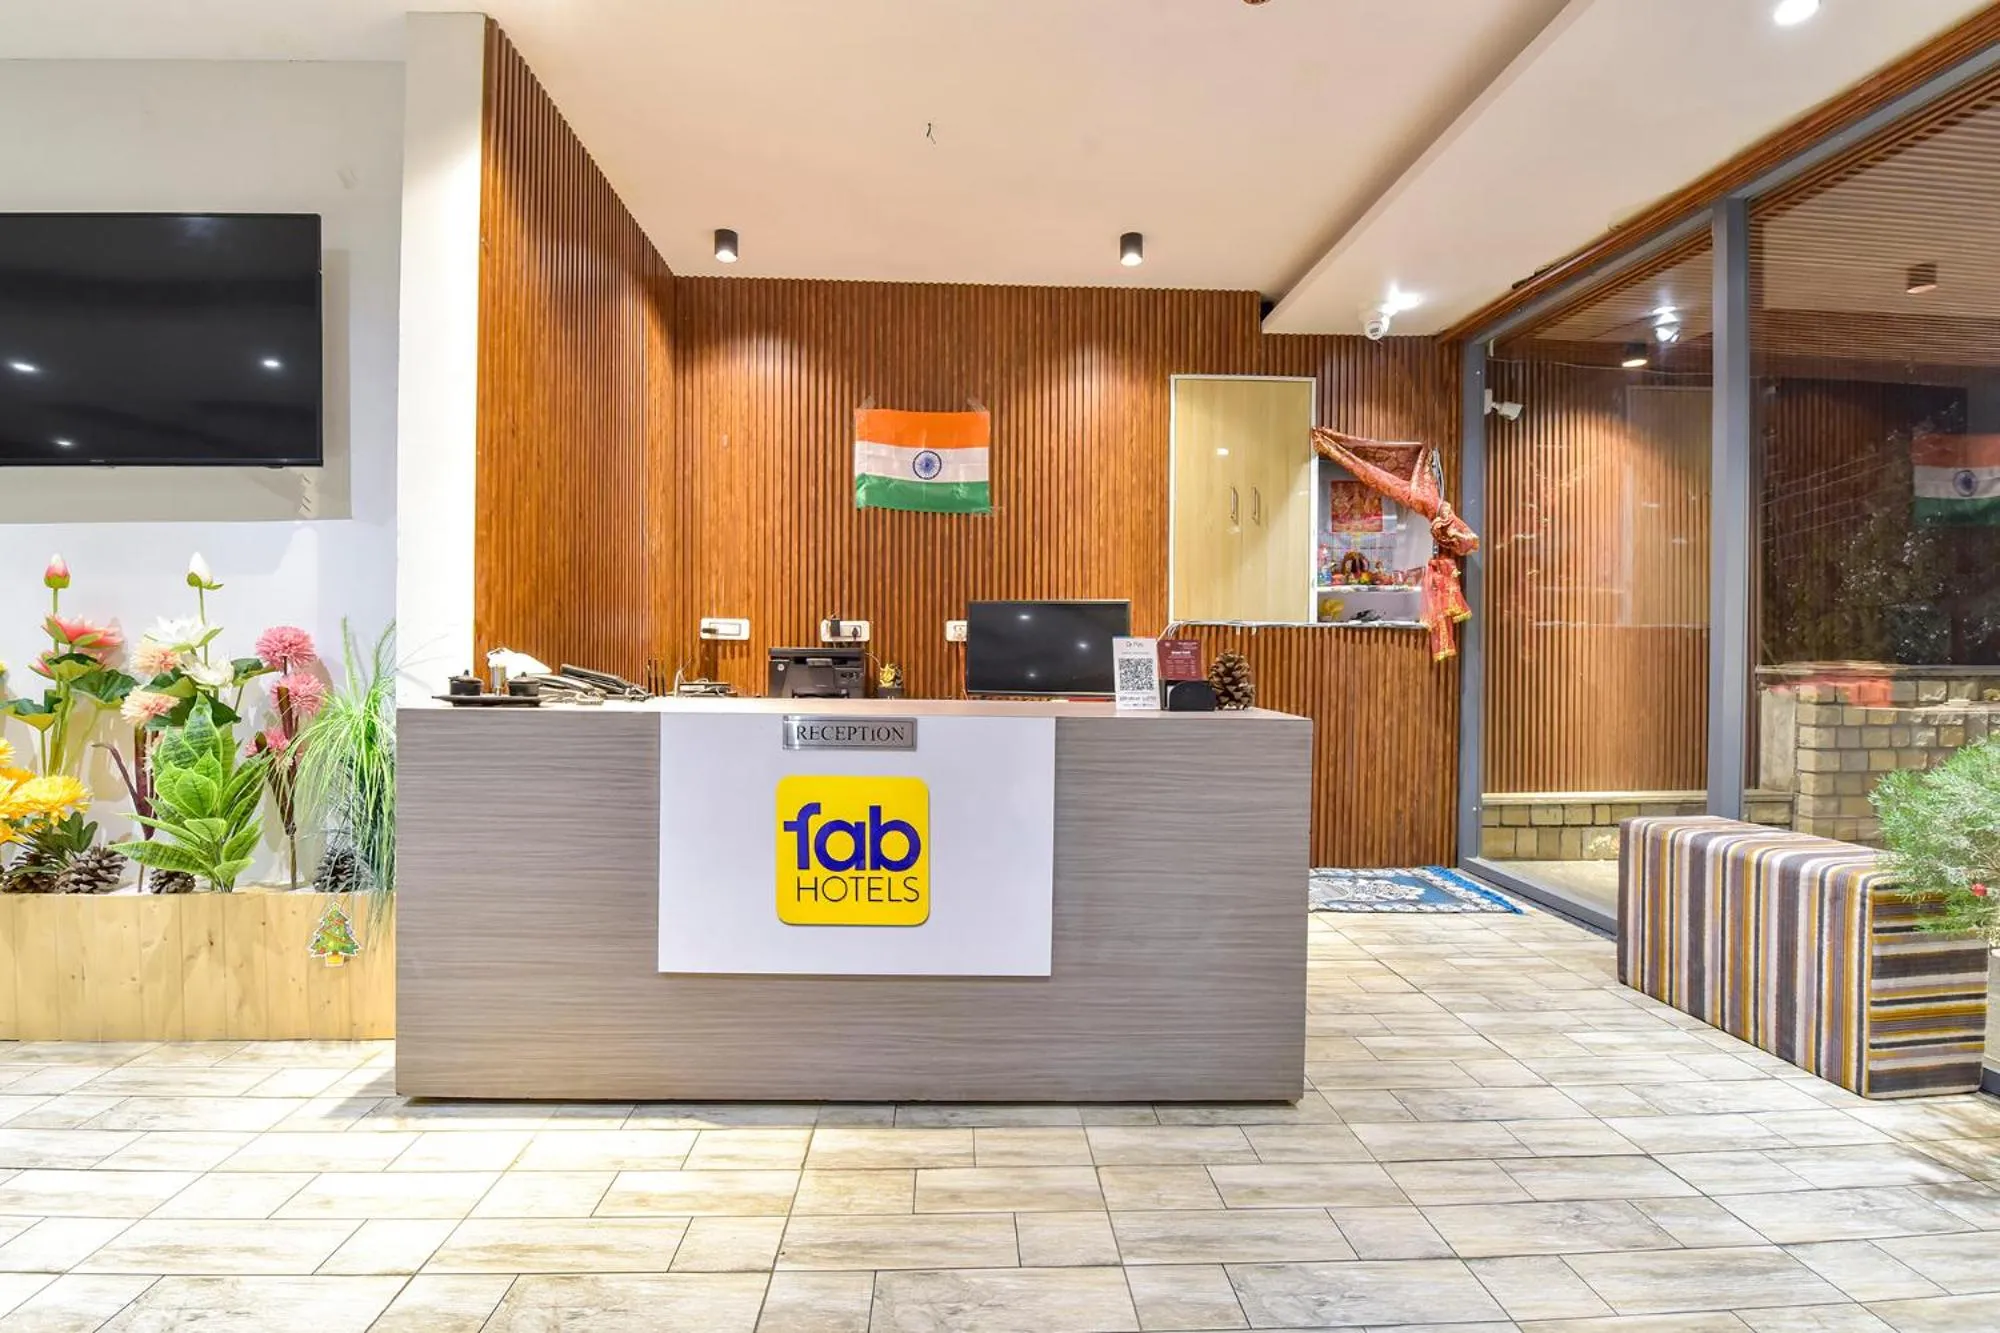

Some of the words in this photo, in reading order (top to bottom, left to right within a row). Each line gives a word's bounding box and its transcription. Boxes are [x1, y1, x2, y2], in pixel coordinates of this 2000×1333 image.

[796, 726, 905, 742] RECEPTION
[783, 802, 922, 872] fab
[796, 875, 920, 902] HOTELS
